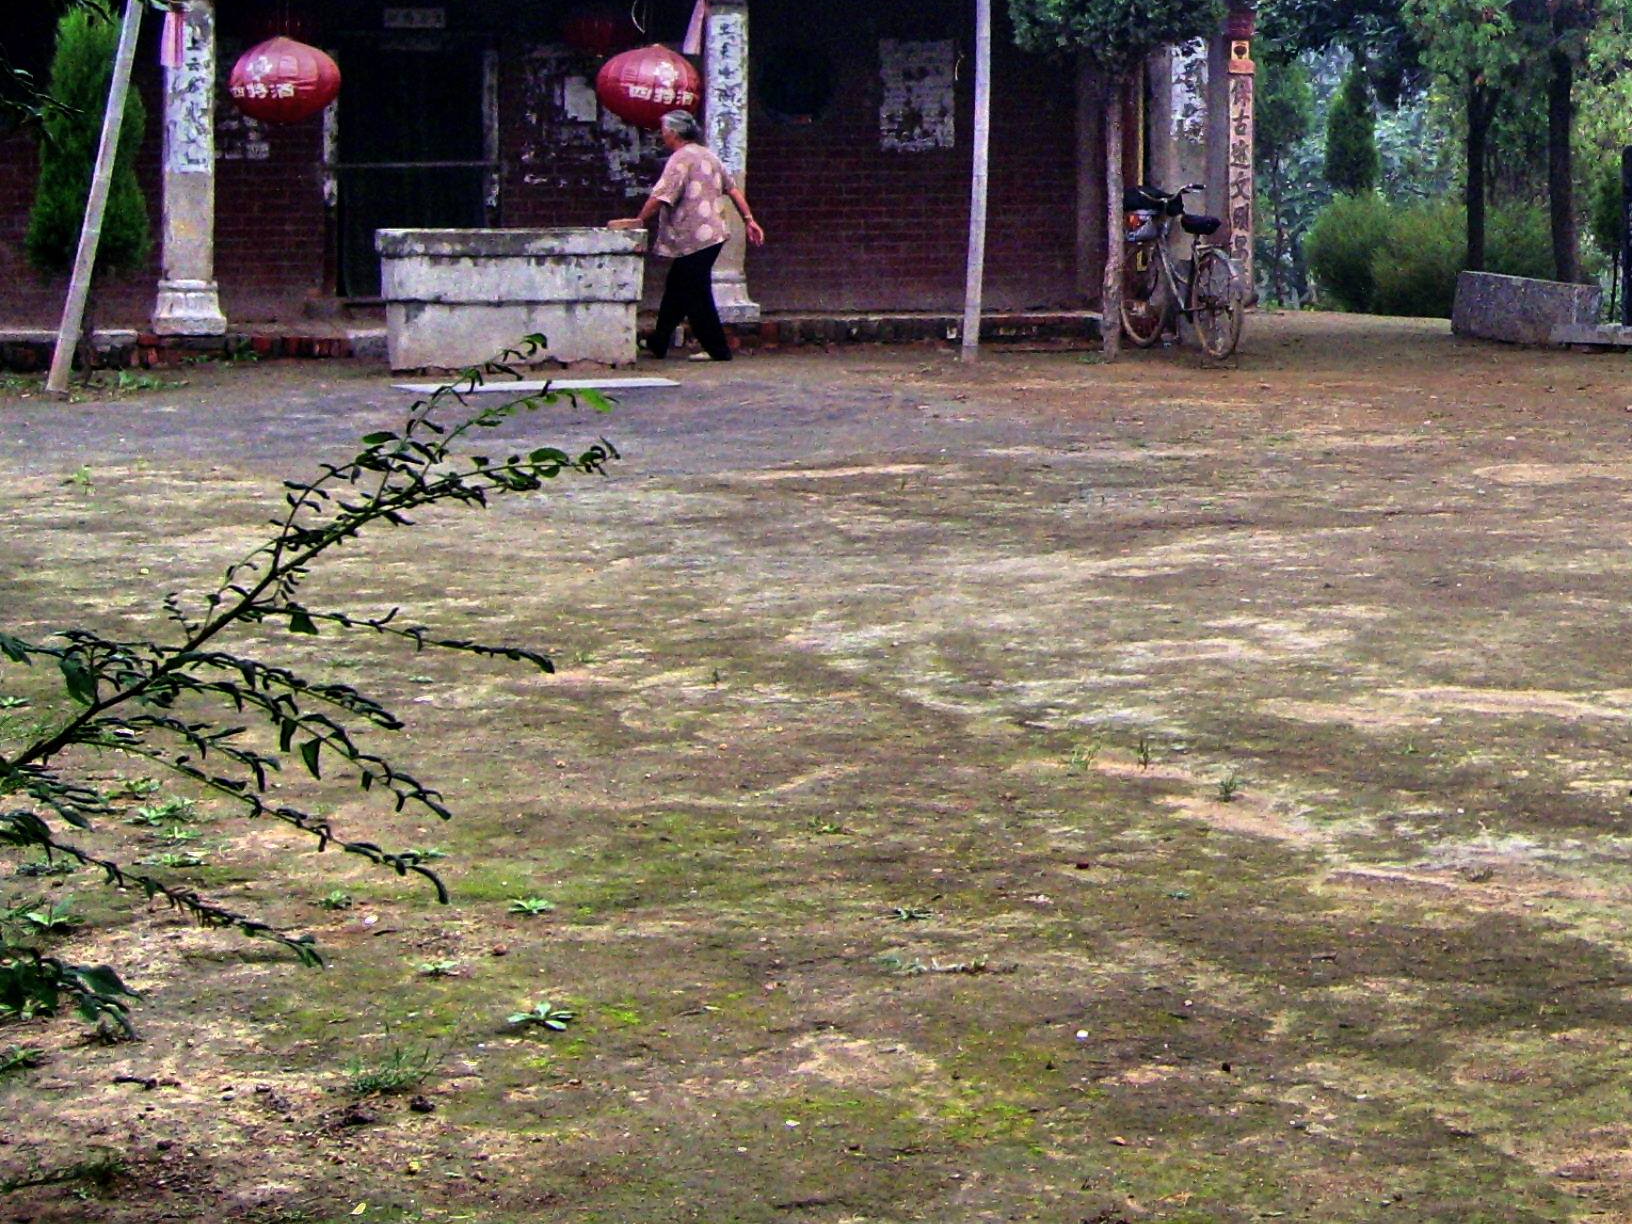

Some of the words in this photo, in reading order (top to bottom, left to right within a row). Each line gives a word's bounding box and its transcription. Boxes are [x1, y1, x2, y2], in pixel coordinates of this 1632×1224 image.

[229, 81, 295, 99] 四特酒
[627, 84, 696, 106] 四特酒
